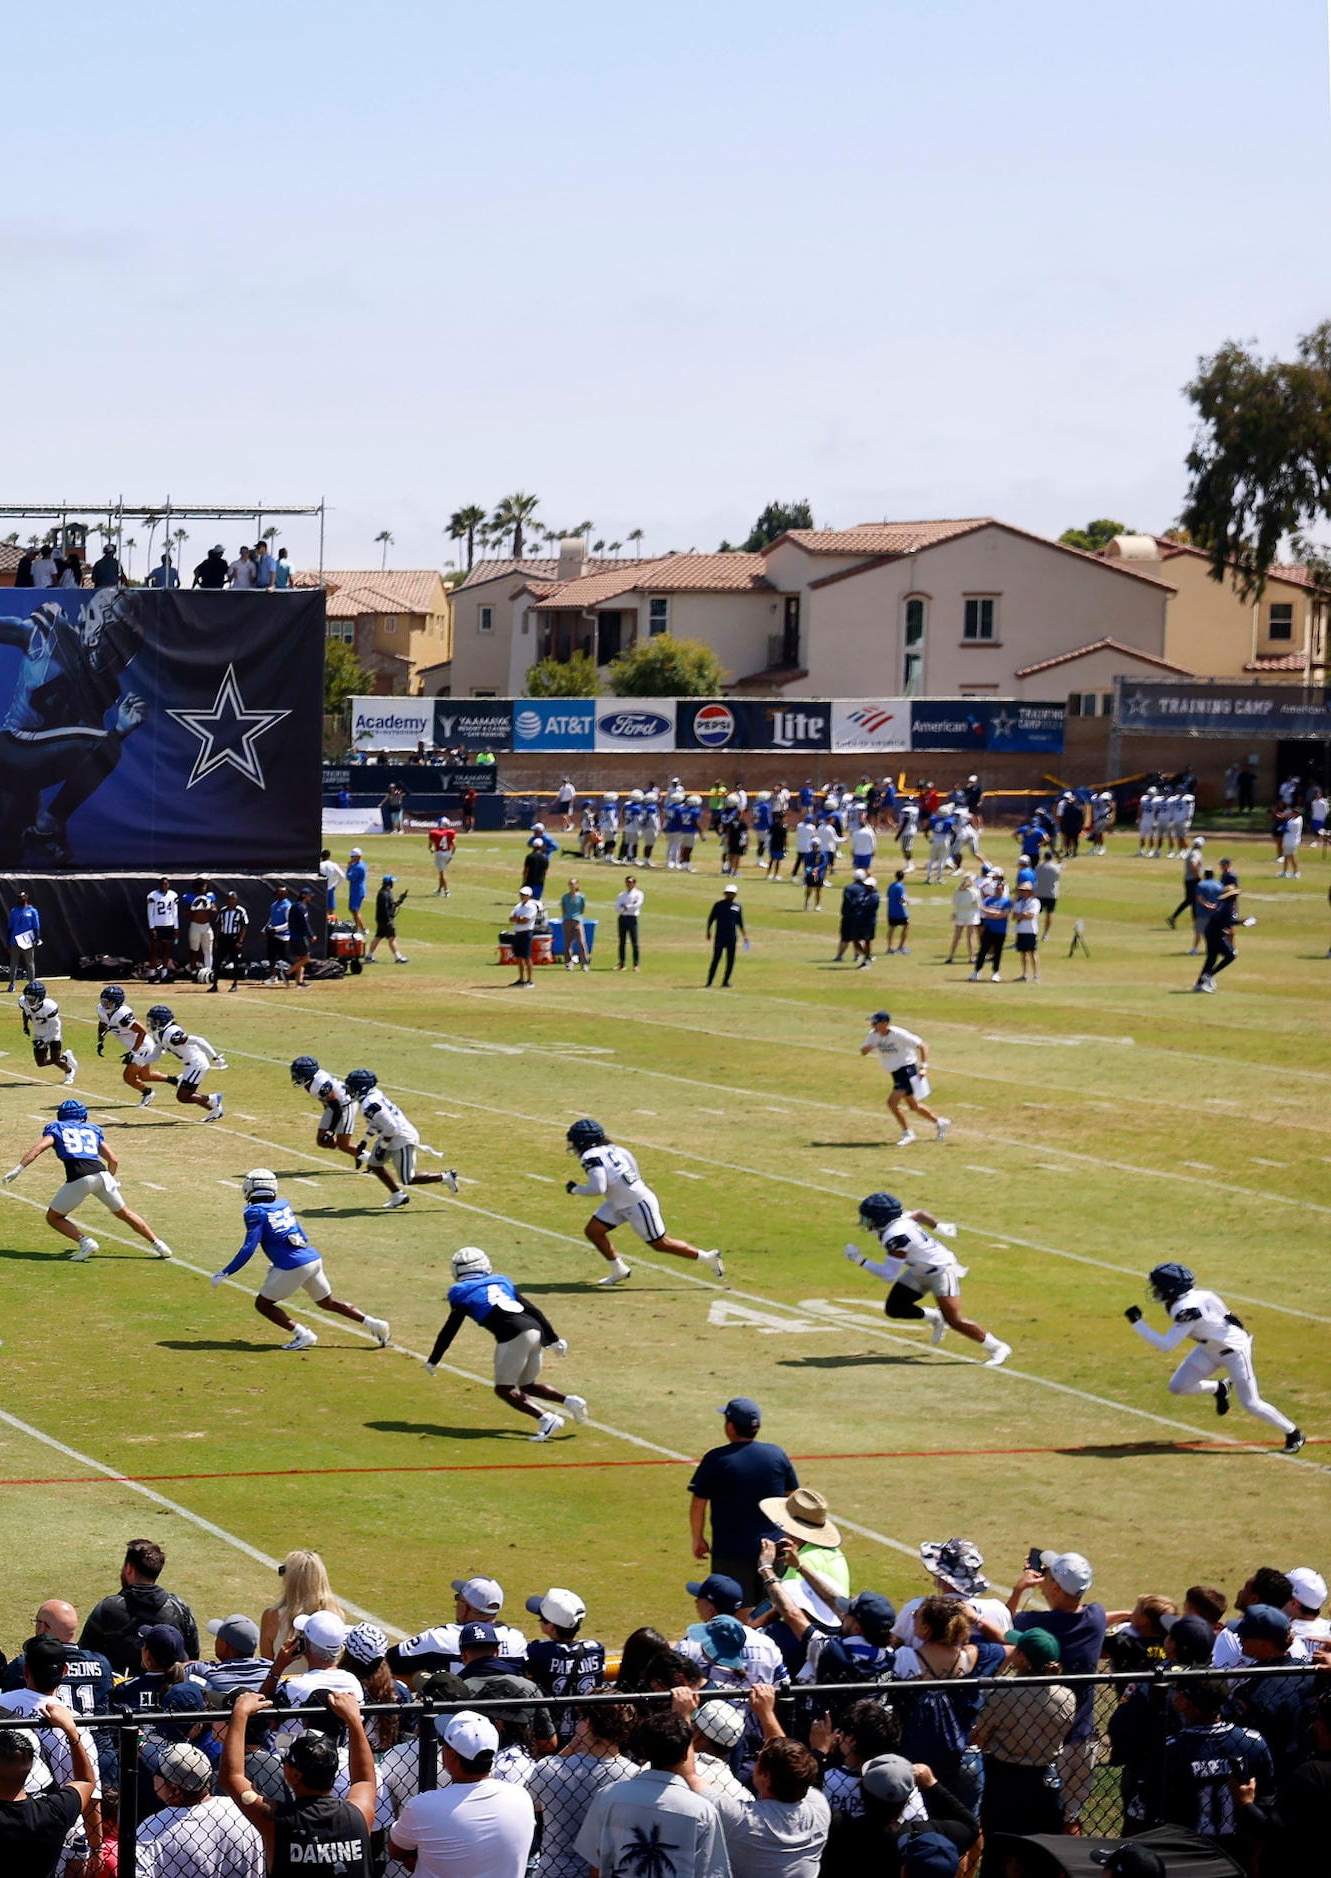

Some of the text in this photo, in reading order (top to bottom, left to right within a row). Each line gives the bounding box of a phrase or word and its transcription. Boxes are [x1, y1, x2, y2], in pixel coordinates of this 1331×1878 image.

[1158, 697, 1231, 714] TRAINING
[1235, 700, 1274, 715] CAMP
[356, 714, 427, 732] Academy
[544, 716, 592, 735] AT&T
[609, 714, 658, 737] Ford
[696, 721, 731, 731] PEPSI
[771, 711, 824, 746] Lite
[912, 721, 967, 733] American
[440, 835, 448, 848] 4
[158, 901, 173, 915] 24
[62, 1128, 99, 1154] 93
[473, 1626, 486, 1639] LA
[550, 1656, 599, 1675] PARONS
[290, 1839, 362, 1865] DAKINE
